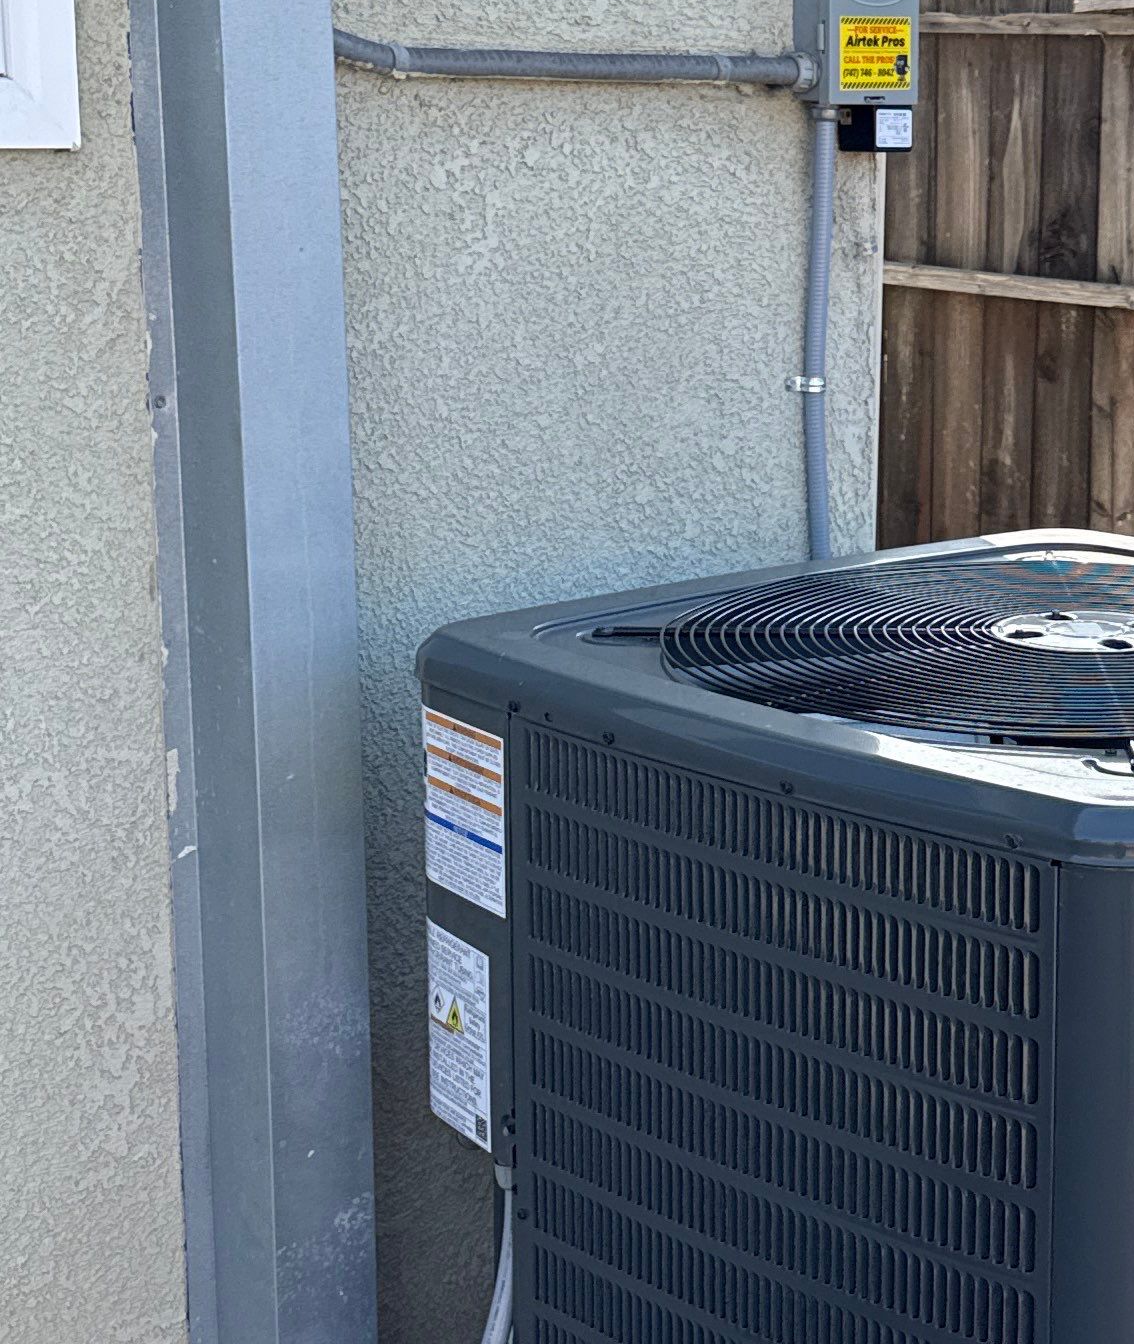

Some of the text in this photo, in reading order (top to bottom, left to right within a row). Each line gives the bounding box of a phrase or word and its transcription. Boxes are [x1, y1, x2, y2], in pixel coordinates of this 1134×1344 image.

[870, 26, 896, 34] SERVICE
[846, 34, 905, 47] Airtek Pros
[844, 56, 861, 64] CALL
[862, 56, 875, 64] THE
